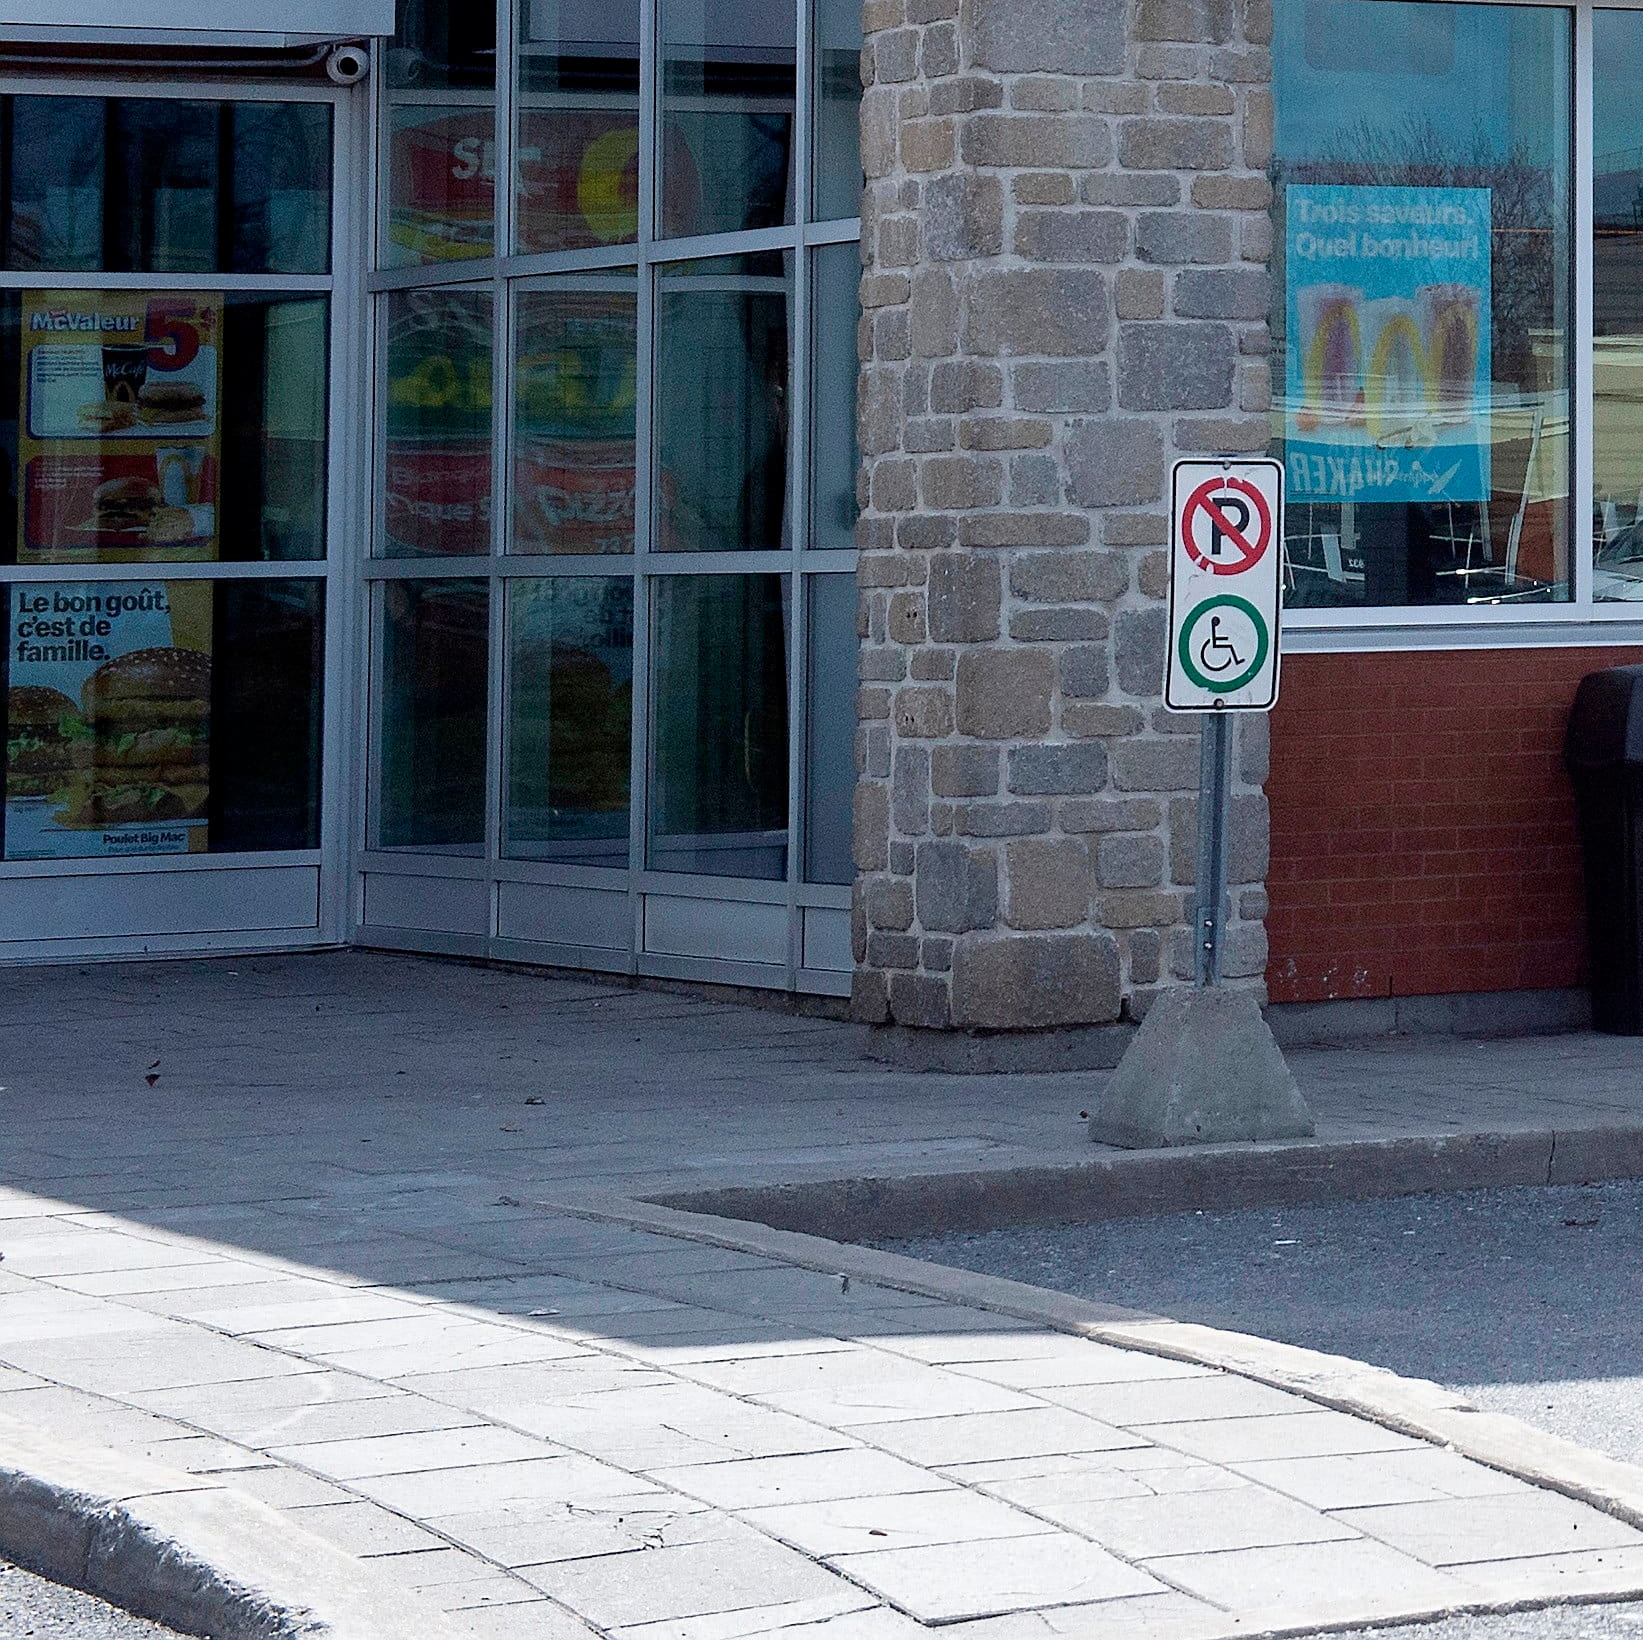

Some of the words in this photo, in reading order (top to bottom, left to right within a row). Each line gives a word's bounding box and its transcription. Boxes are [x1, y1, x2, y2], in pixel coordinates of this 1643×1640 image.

[1297, 230, 1358, 260] Quel
[30, 311, 139, 332] McValeur
[1211, 497, 1250, 555] P
[19, 591, 50, 613] Le
[53, 591, 101, 612] bon
[105, 588, 171, 618] goût,
[17, 616, 76, 638] c'est
[79, 615, 112, 636] de
[16, 639, 111, 662] famille.
